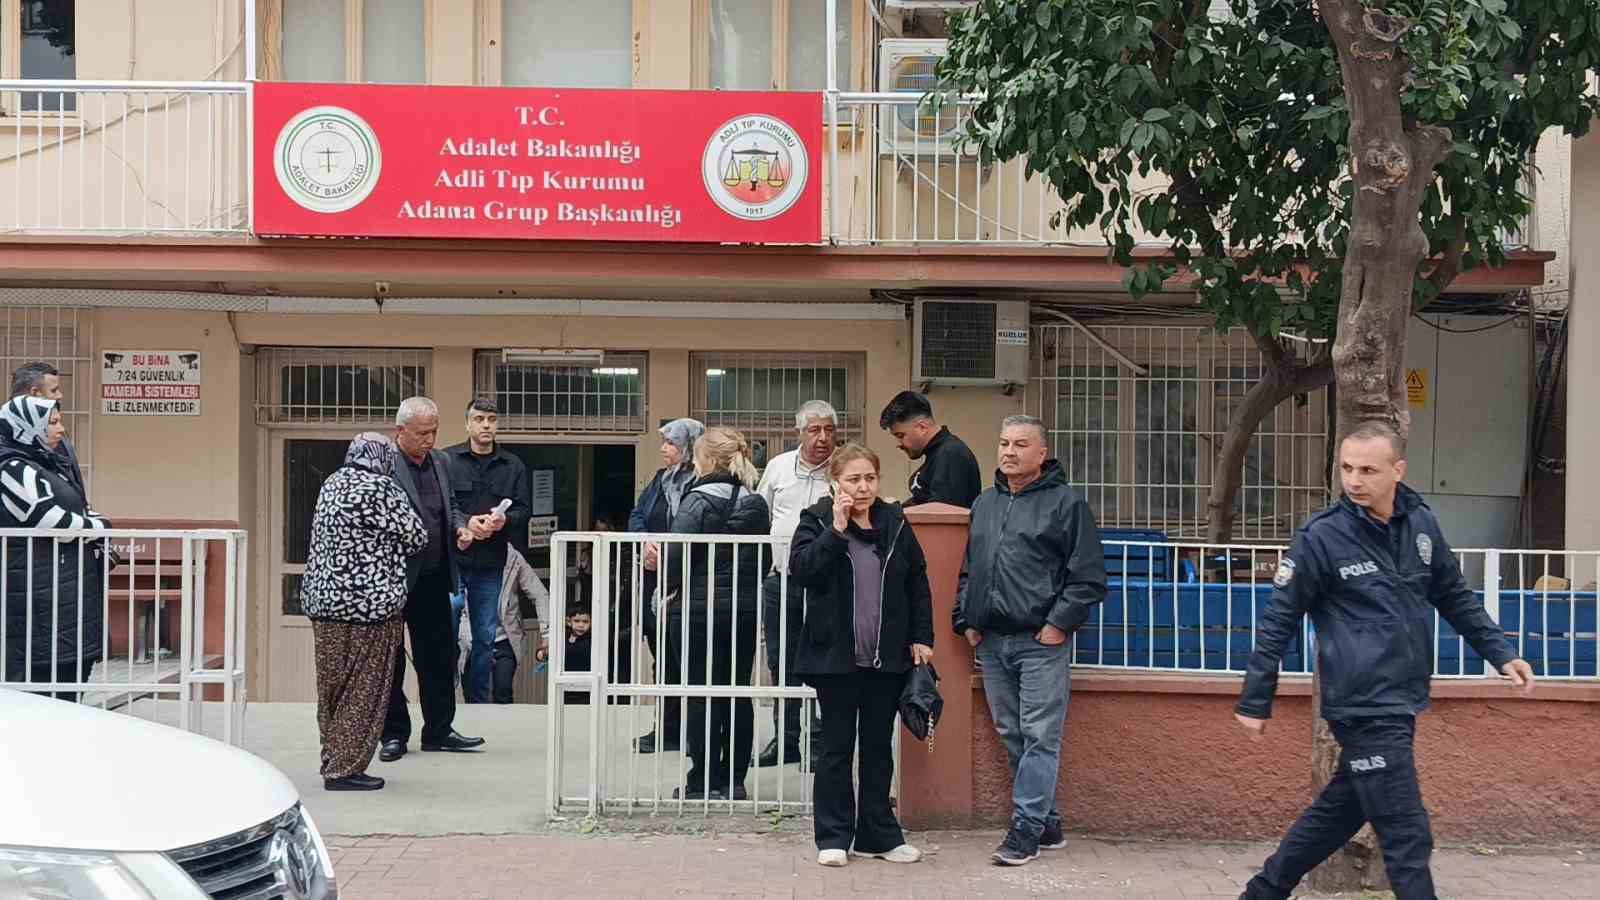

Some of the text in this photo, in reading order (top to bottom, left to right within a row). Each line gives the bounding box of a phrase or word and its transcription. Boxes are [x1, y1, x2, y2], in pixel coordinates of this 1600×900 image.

[514, 105, 566, 126] T.C.
[759, 120, 797, 149] KURUMU
[439, 136, 641, 164] Adalet Bakanlığı
[434, 168, 645, 194] Adli Tıp Kurumu
[396, 199, 682, 228] Adana Grup Başkanlığı
[132, 354, 146, 366] BU
[103, 385, 143, 398] KAMERA
